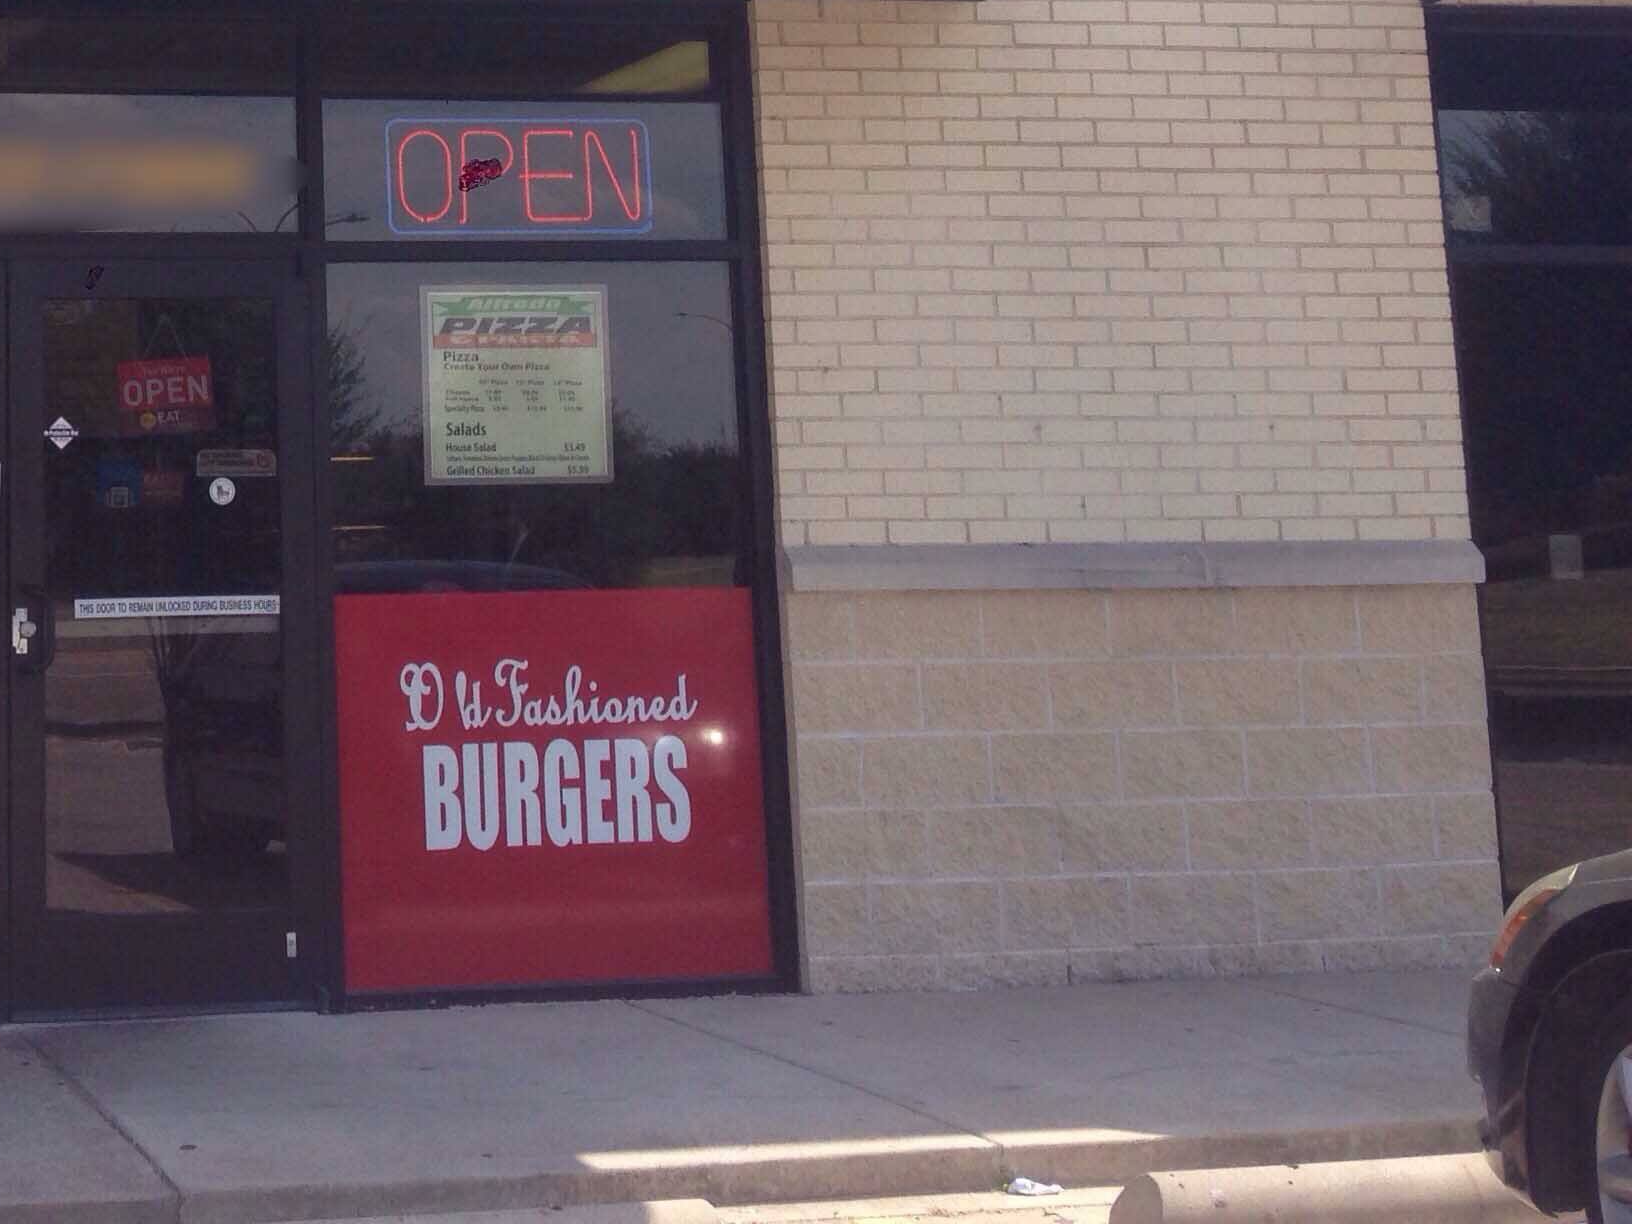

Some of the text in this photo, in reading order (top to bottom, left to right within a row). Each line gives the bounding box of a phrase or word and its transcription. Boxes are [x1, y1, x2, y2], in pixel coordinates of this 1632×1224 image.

[397, 129, 641, 224] OPEN
[439, 317, 592, 335] PIZZA
[443, 351, 479, 362] Pizza
[123, 375, 209, 406] OPEN
[446, 422, 487, 436] Salads
[96, 603, 115, 613] DOOR
[118, 602, 127, 613] TO
[494, 658, 698, 726] Fashioned
[423, 735, 692, 850] BURGERS
